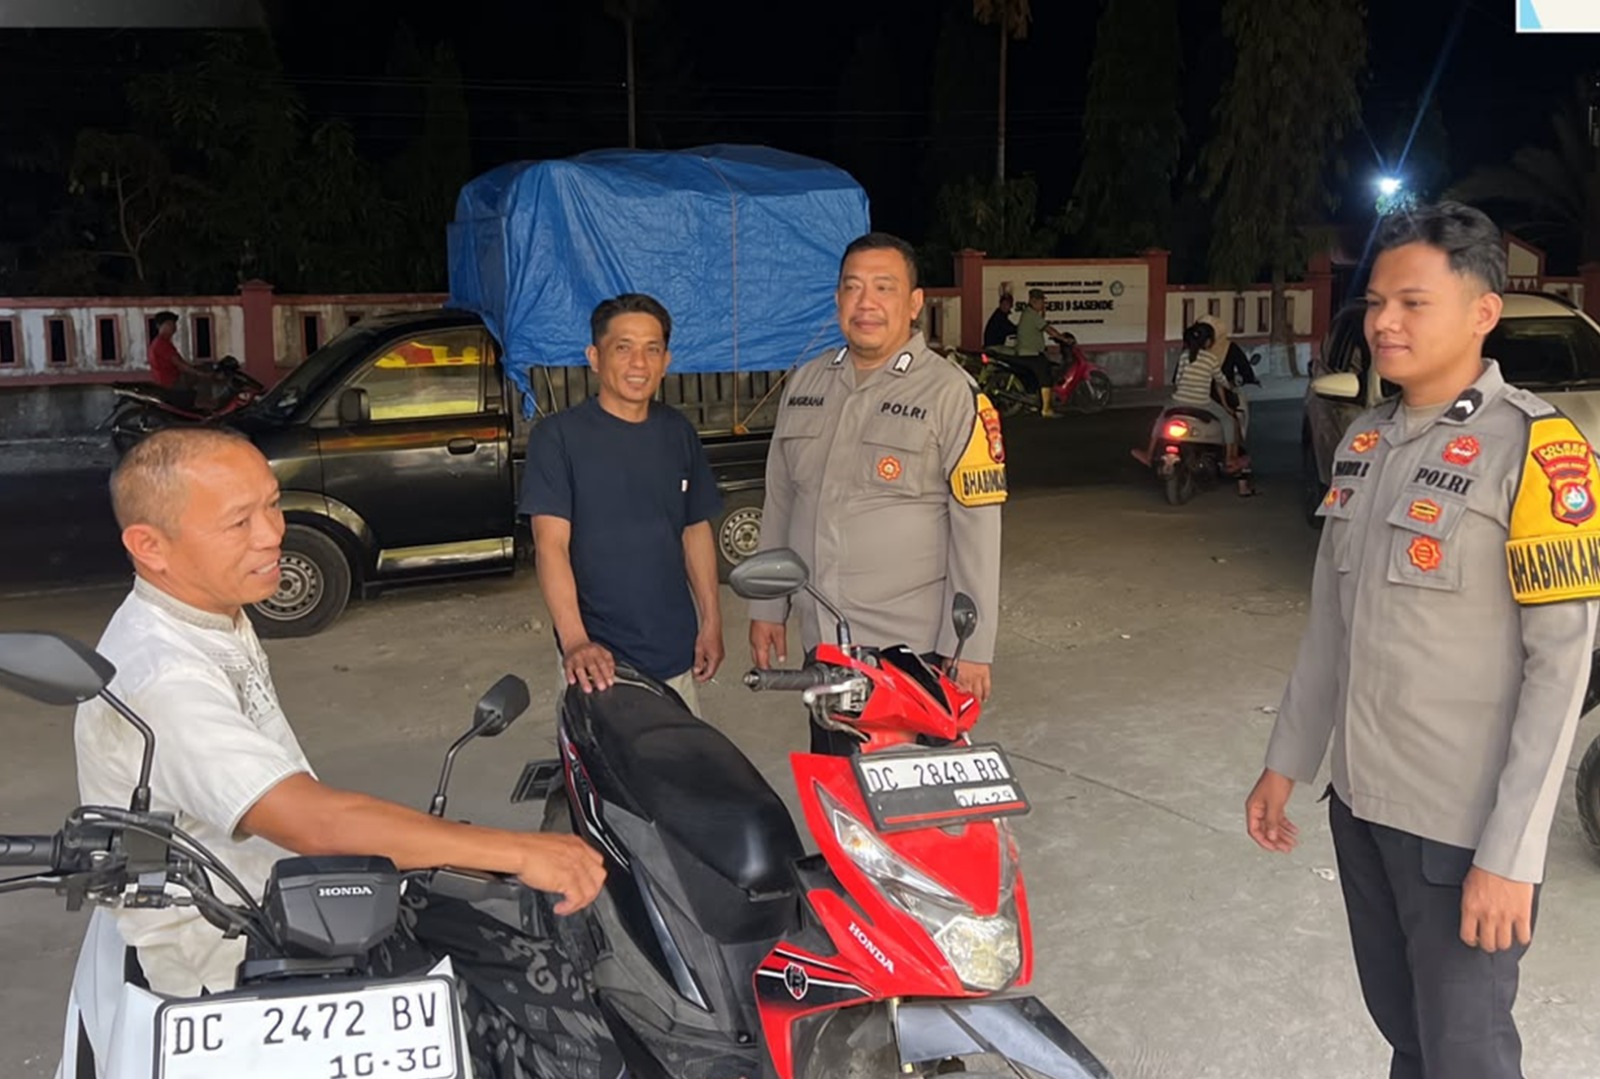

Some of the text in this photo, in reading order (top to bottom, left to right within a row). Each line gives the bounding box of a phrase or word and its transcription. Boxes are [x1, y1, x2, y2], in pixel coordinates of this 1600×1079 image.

[881, 402, 927, 420] POLRI
[1413, 467, 1475, 496] POLRI
[867, 758, 1002, 792] DC 2848 BR
[318, 885, 373, 897] HONDA
[848, 921, 895, 975] HONDA
[172, 992, 437, 1055] DC 2472 BV
